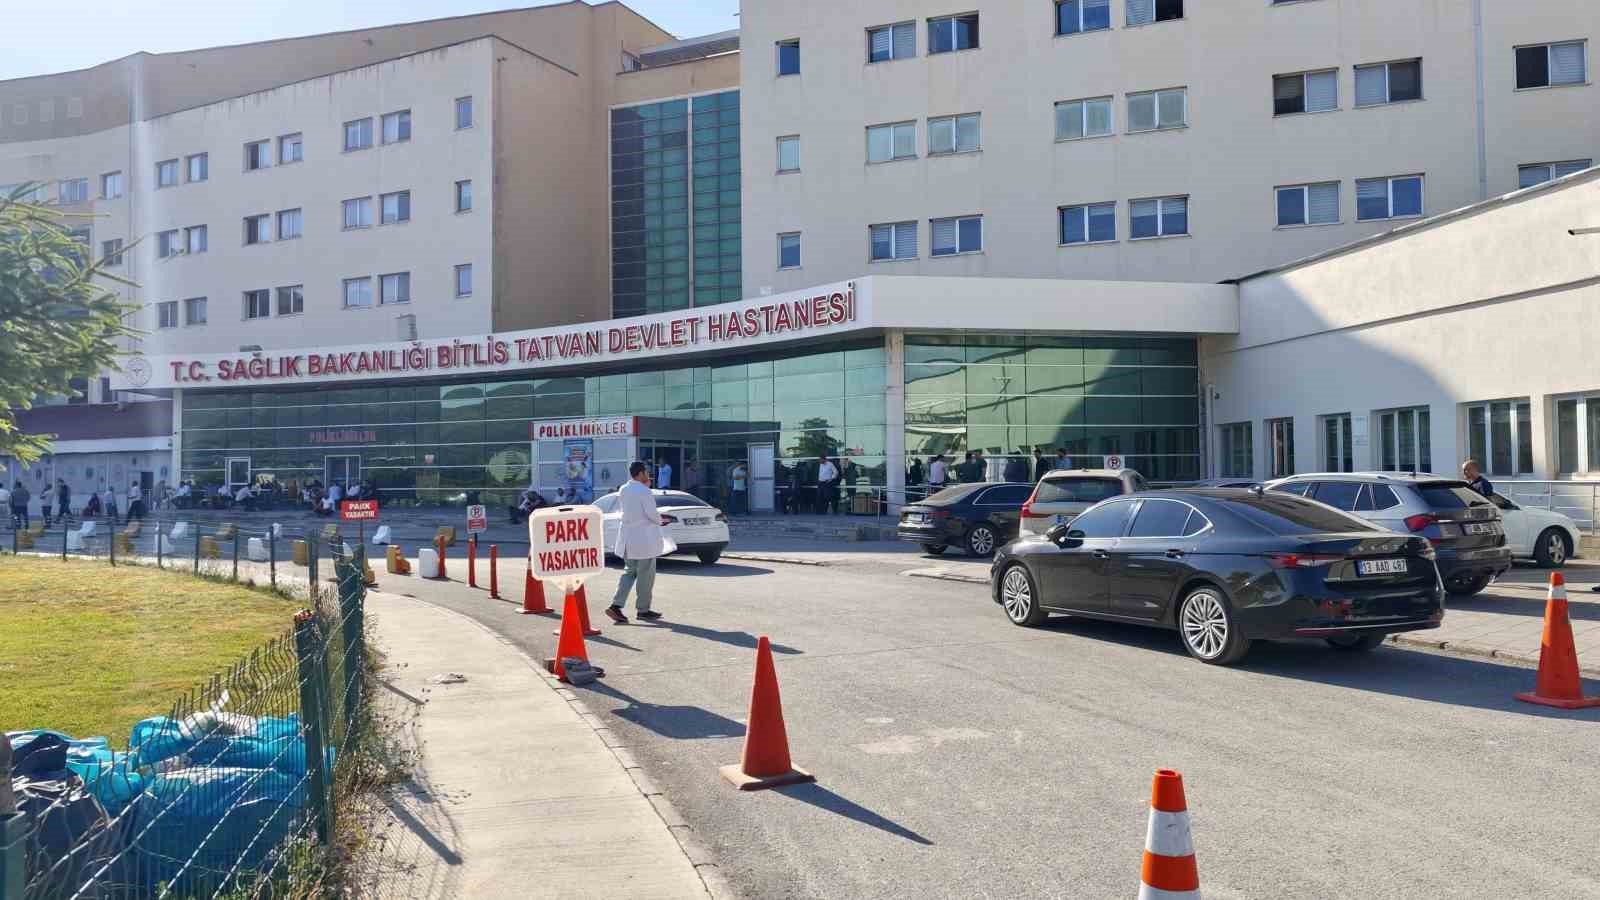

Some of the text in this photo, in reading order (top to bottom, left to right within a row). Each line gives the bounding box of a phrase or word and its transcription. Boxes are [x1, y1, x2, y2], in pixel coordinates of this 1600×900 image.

[170, 281, 856, 381] T.C. SAĞLIK BAKANLIĞI BİTLİS TATVAN DEVLET HASTANESİ
[545, 518, 589, 543] PARK
[539, 547, 599, 571] YASAKTIR
